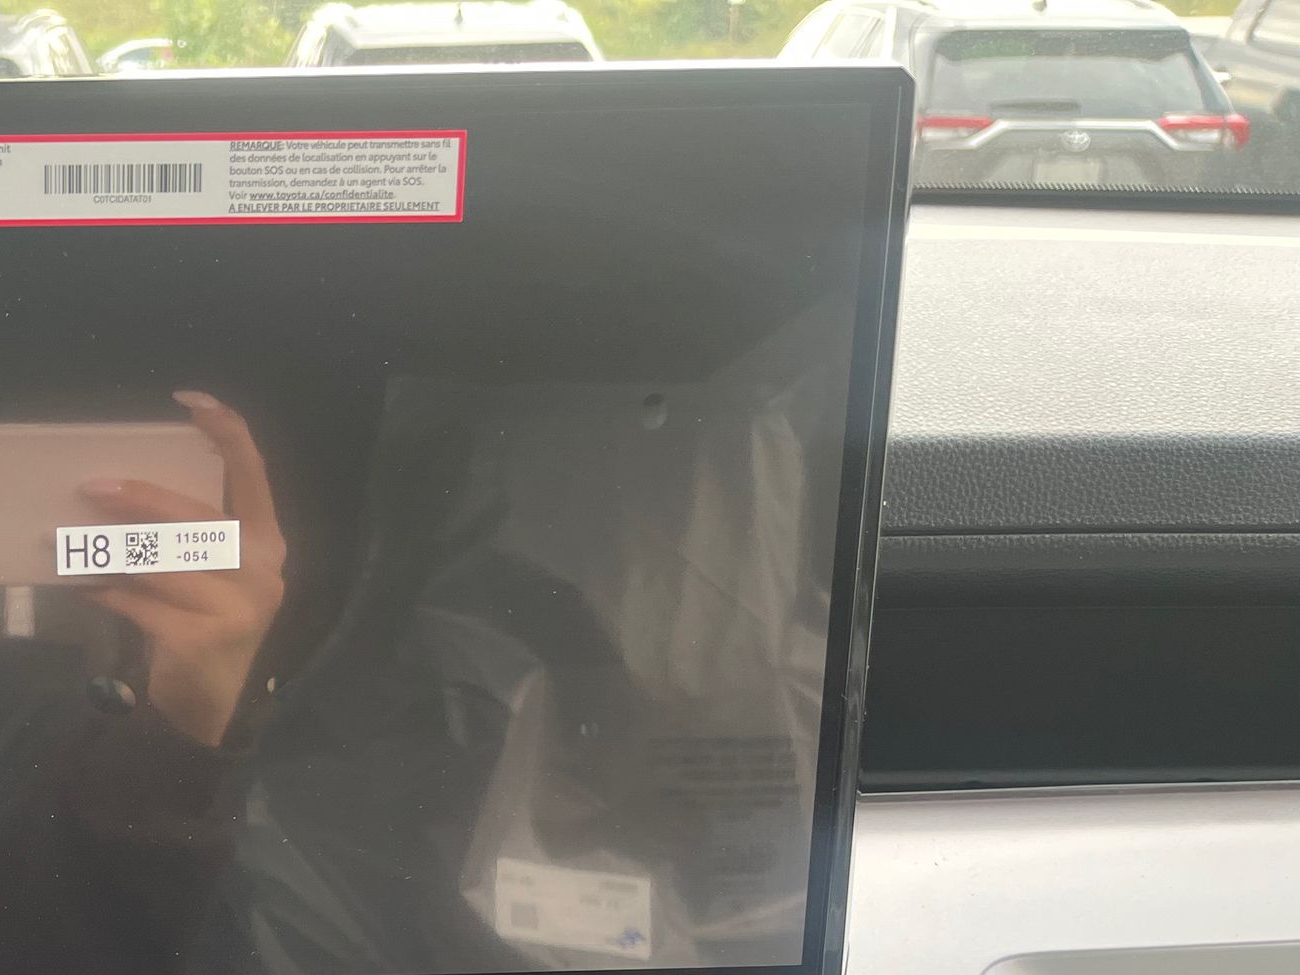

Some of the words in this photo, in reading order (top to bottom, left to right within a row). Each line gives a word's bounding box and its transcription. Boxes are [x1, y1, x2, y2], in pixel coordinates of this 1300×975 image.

[286, 141, 309, 149] Votre
[311, 140, 347, 149] véhicule
[348, 142, 368, 150] peut
[370, 140, 419, 149] transmettre
[421, 140, 440, 148] sans
[248, 154, 286, 162] données
[288, 153, 300, 162] de
[302, 153, 353, 162] localisation
[369, 153, 411, 163] appuyant
[429, 152, 437, 160] le
[229, 166, 262, 175] bouton
[265, 166, 283, 174] SOS
[329, 165, 340, 174] de
[342, 165, 381, 174] collision.
[384, 165, 405, 173] Pour
[406, 164, 436, 173] arrêter
[438, 164, 446, 173] la
[229, 179, 288, 188] transmission,
[290, 178, 337, 187] demandez
[360, 178, 386, 188] agent
[388, 177, 400, 186] via
[402, 177, 424, 186] SOS.
[229, 191, 247, 199] Voir
[237, 203, 280, 213] ENLEVER
[282, 203, 300, 213] PAR
[302, 203, 313, 212] LE
[315, 202, 381, 212] PROPRIETAIRE
[383, 201, 440, 211] SEULEMENT
[176, 531, 226, 544] 115000
[66, 534, 111, 569] H8
[176, 551, 209, 562] -054
